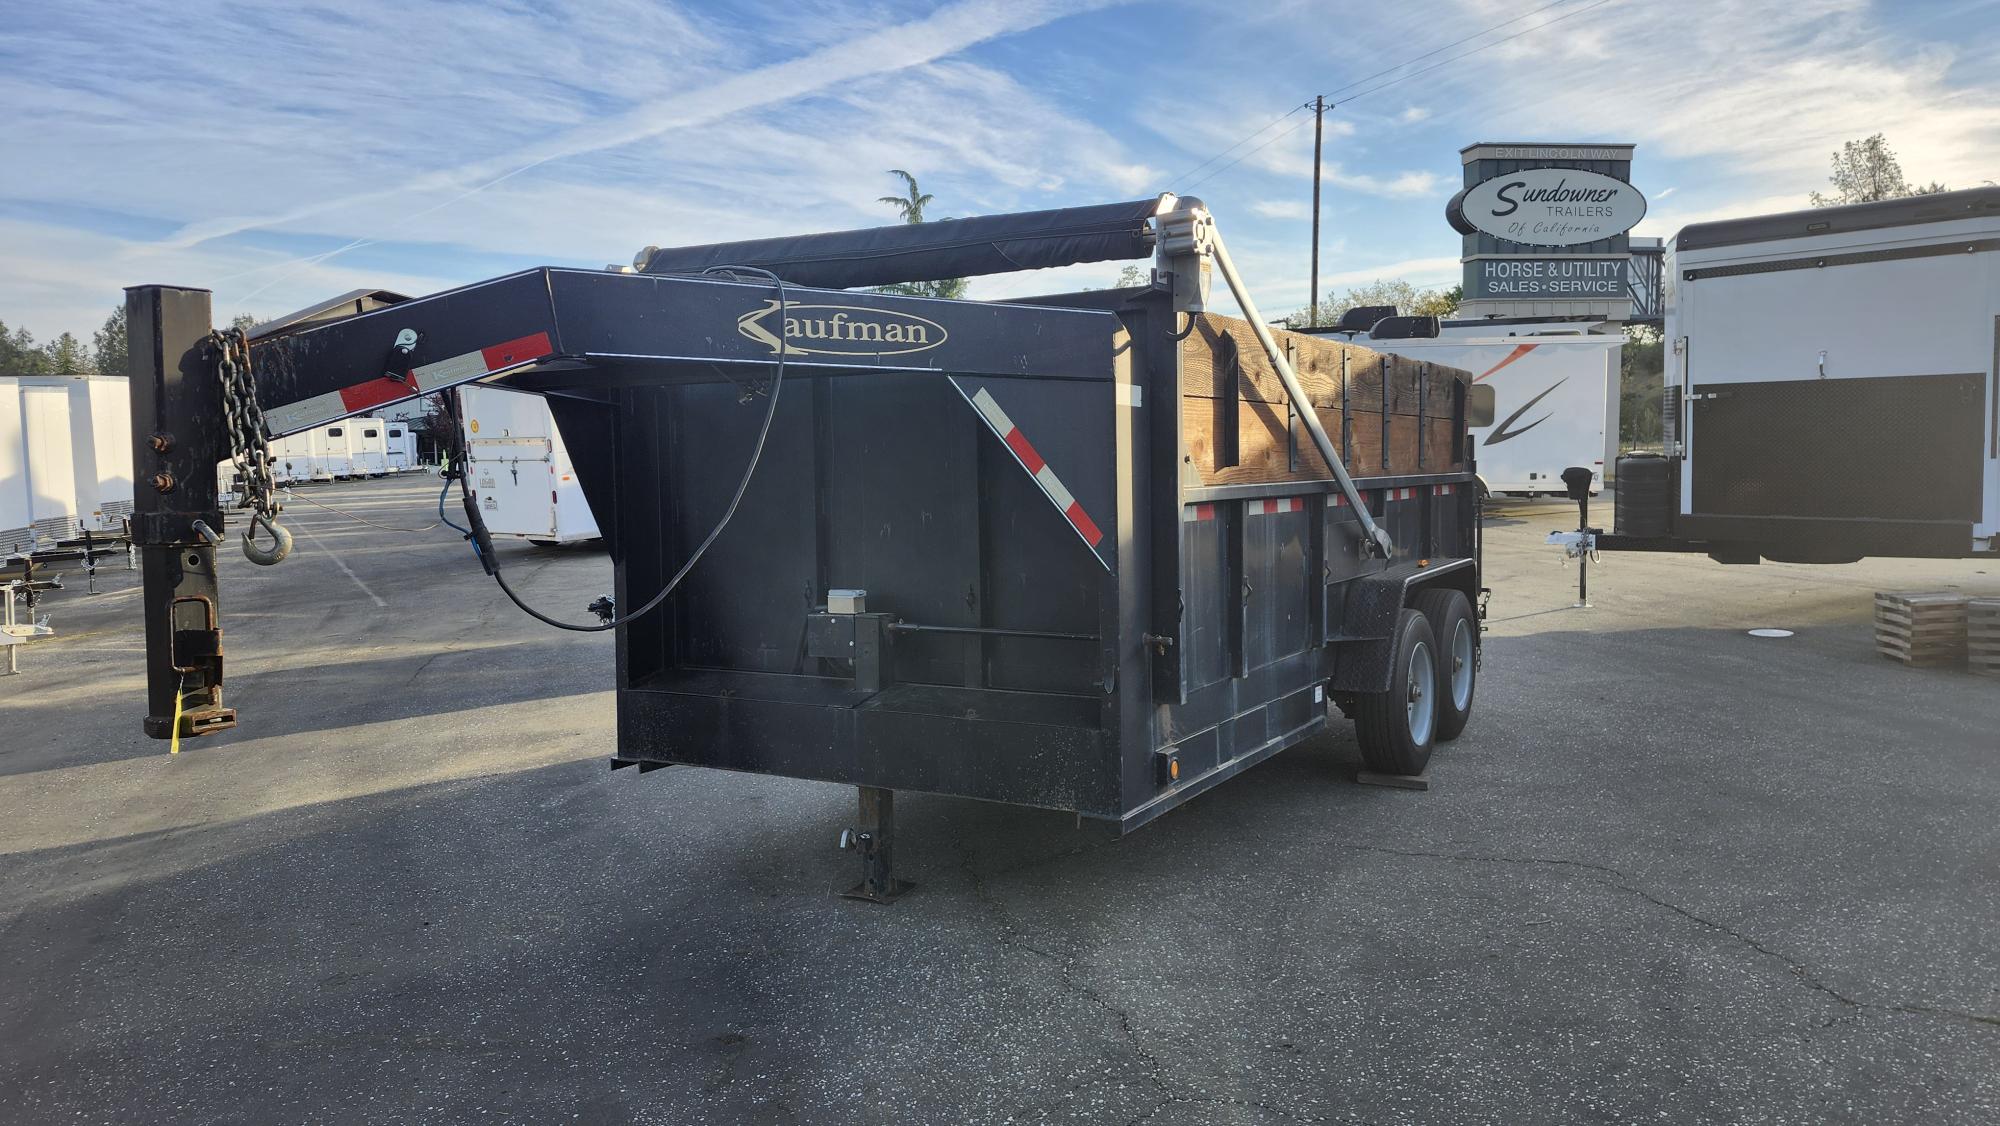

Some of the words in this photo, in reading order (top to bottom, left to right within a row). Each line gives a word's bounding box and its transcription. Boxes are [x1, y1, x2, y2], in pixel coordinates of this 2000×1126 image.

[1495, 148, 1527, 158] EXIT
[1528, 148, 1587, 158] LINCOLN
[1590, 148, 1618, 159] WAY
[1491, 178, 1618, 217] Sundowner
[1547, 206, 1613, 217] TRAILERS
[1508, 222, 1525, 237] Of
[1533, 221, 1600, 237] California
[1485, 262, 1544, 278] HORSE
[1549, 262, 1559, 278] &
[1562, 262, 1621, 277] UTILITY
[738, 299, 929, 356] Kaufman
